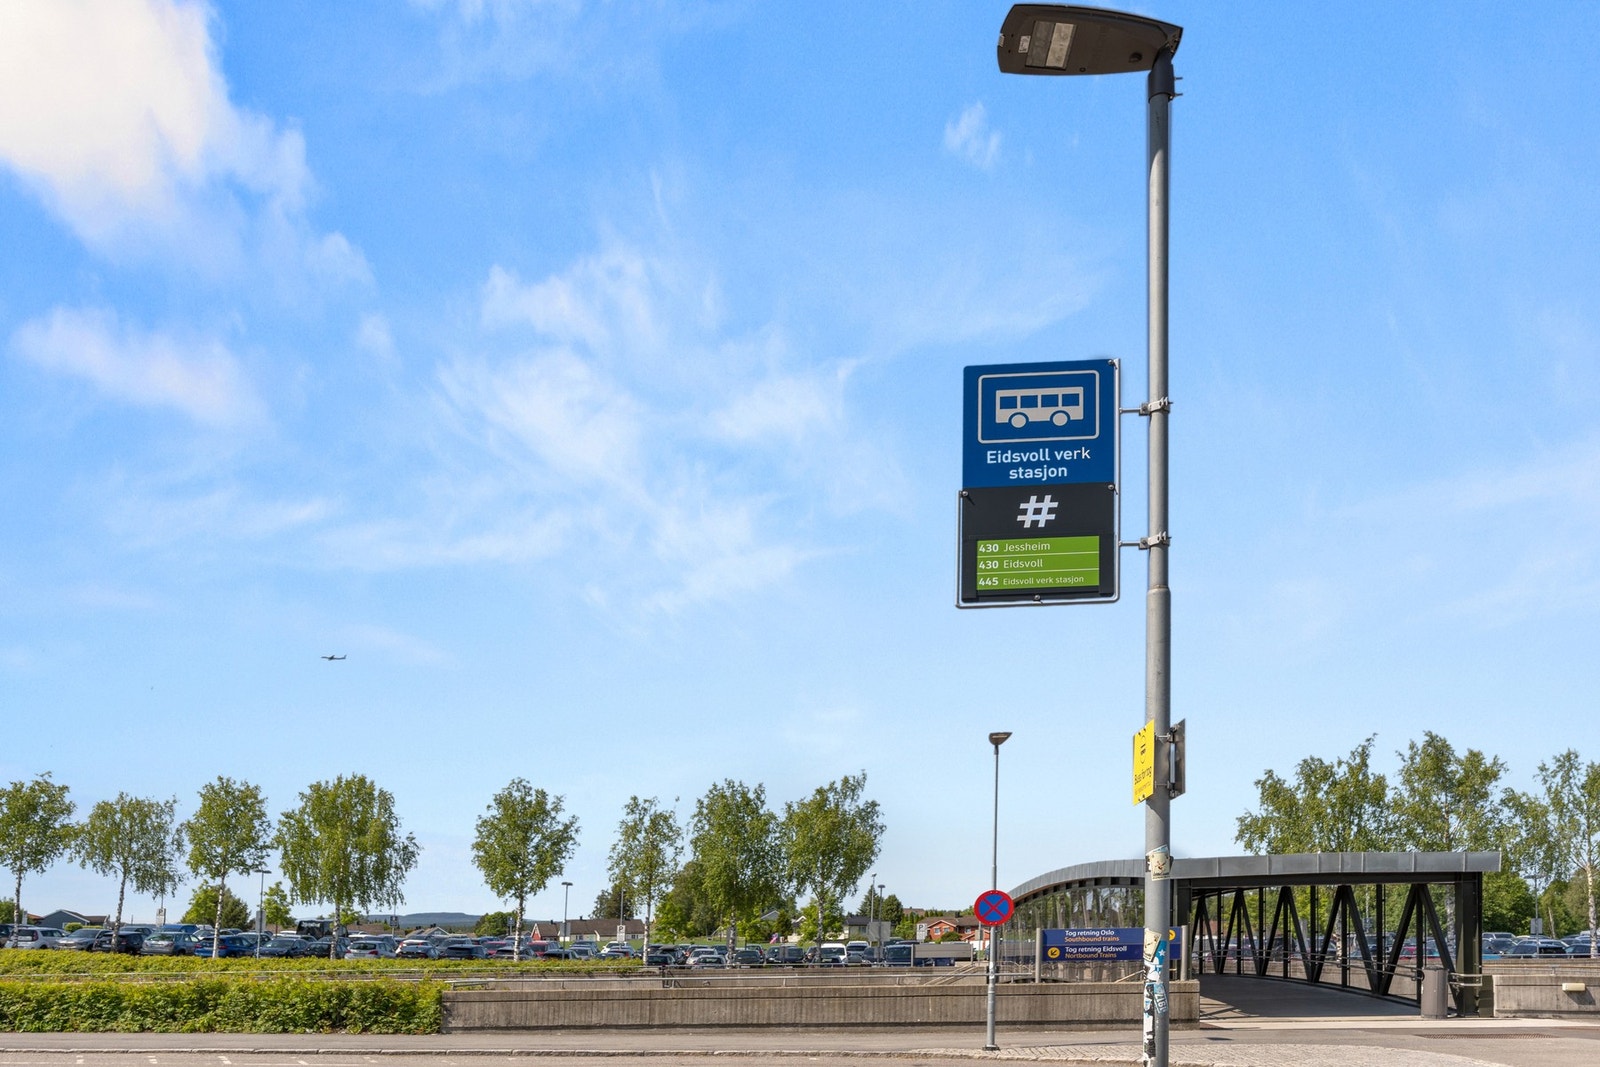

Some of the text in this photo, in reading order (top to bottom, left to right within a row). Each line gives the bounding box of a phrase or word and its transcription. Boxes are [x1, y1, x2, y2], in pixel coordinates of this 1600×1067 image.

[987, 447, 1091, 464] Eidsvoll verk
[1009, 465, 1068, 480] stasjon
[979, 542, 1051, 553] 430 Jessheim
[979, 559, 1043, 570] 430 Eidsvoll
[979, 578, 999, 586] 445
[1056, 576, 1084, 585] stasjon
